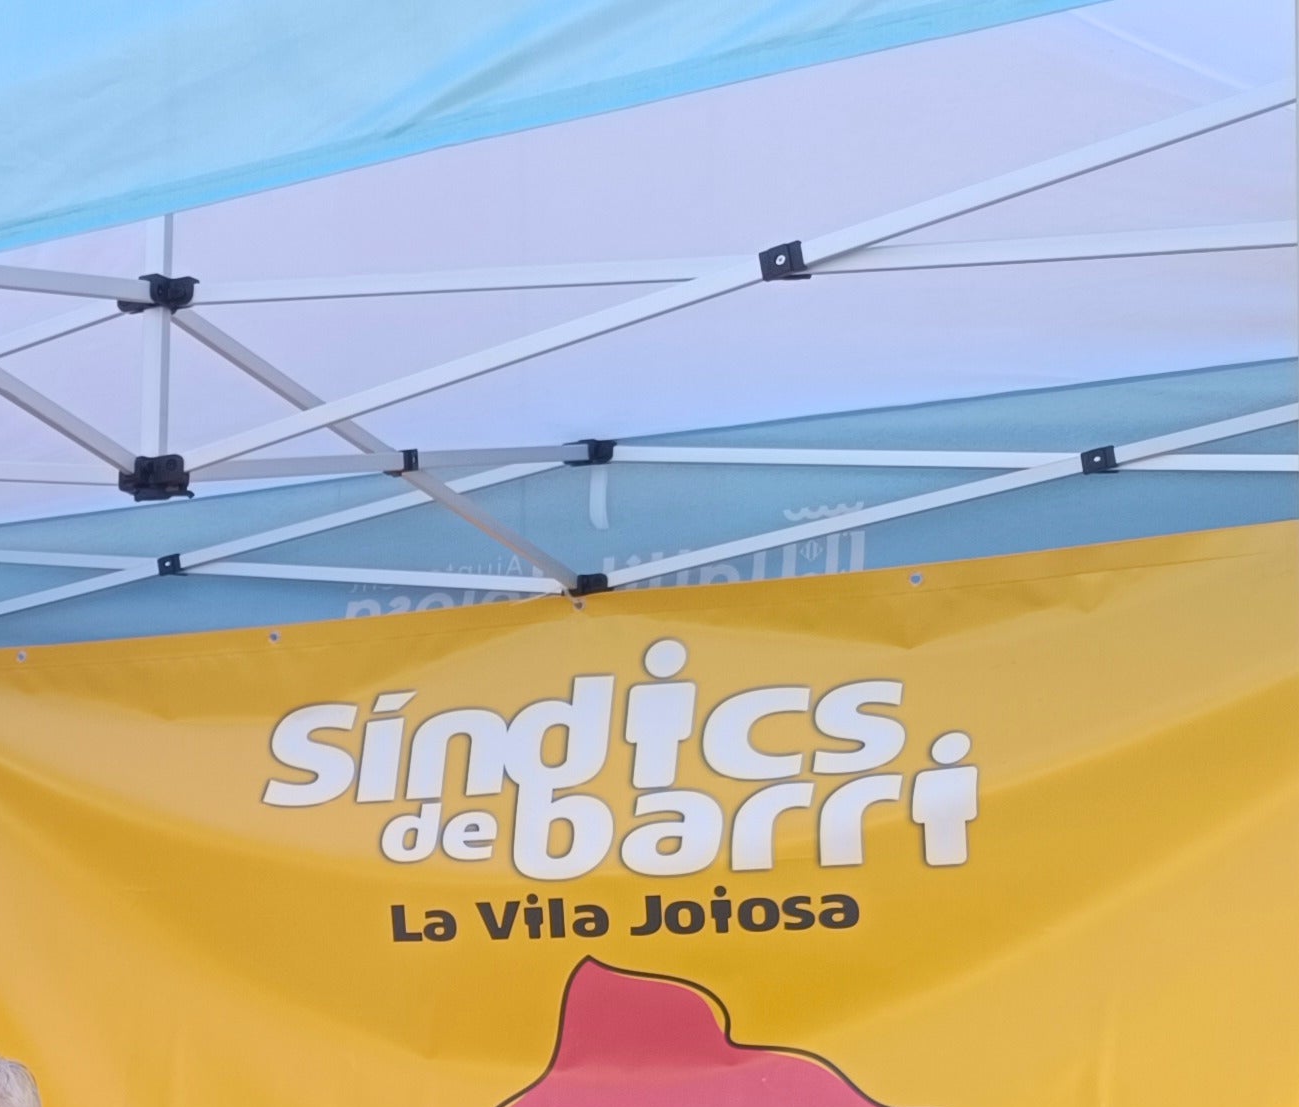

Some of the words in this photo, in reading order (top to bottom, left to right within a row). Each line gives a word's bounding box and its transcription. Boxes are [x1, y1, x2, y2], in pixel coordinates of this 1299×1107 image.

[261, 638, 906, 807] Síndics
[379, 800, 498, 864] de
[512, 731, 979, 881] barri
[390, 903, 457, 943] La
[476, 893, 610, 941] Vila
[630, 885, 861, 938] Joiosa
